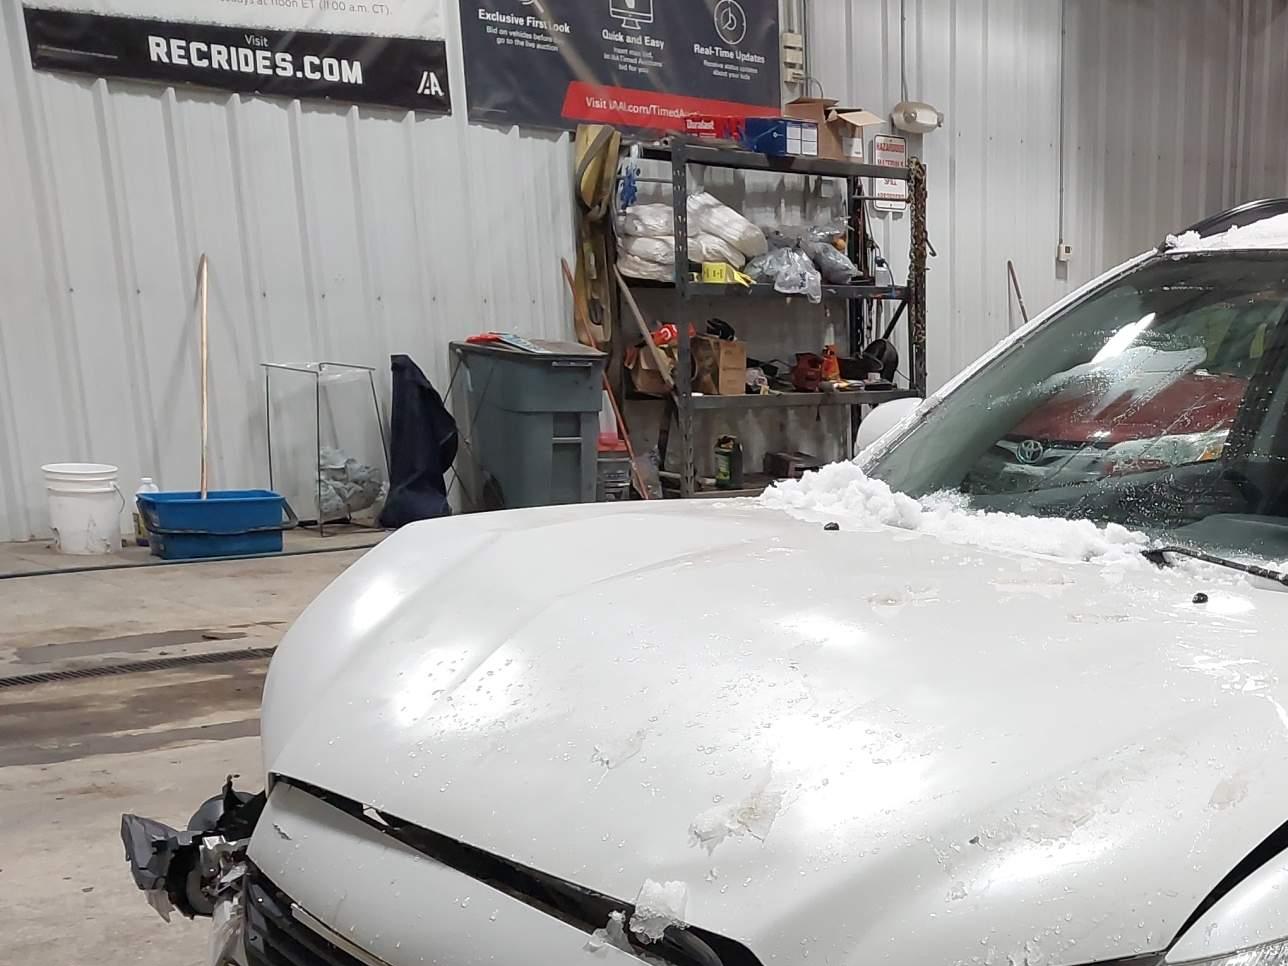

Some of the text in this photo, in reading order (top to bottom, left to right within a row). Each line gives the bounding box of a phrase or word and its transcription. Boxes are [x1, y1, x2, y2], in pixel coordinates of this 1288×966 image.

[301, 0, 314, 9] ET
[478, 8, 525, 26] Exclusive
[526, 16, 548, 30] First
[244, 33, 269, 48] Visit
[601, 29, 665, 50] Quick and Easy
[147, 35, 364, 85] RECRIDES.COM
[693, 43, 766, 64] Real-Time Updates
[586, 97, 607, 110] Visit
